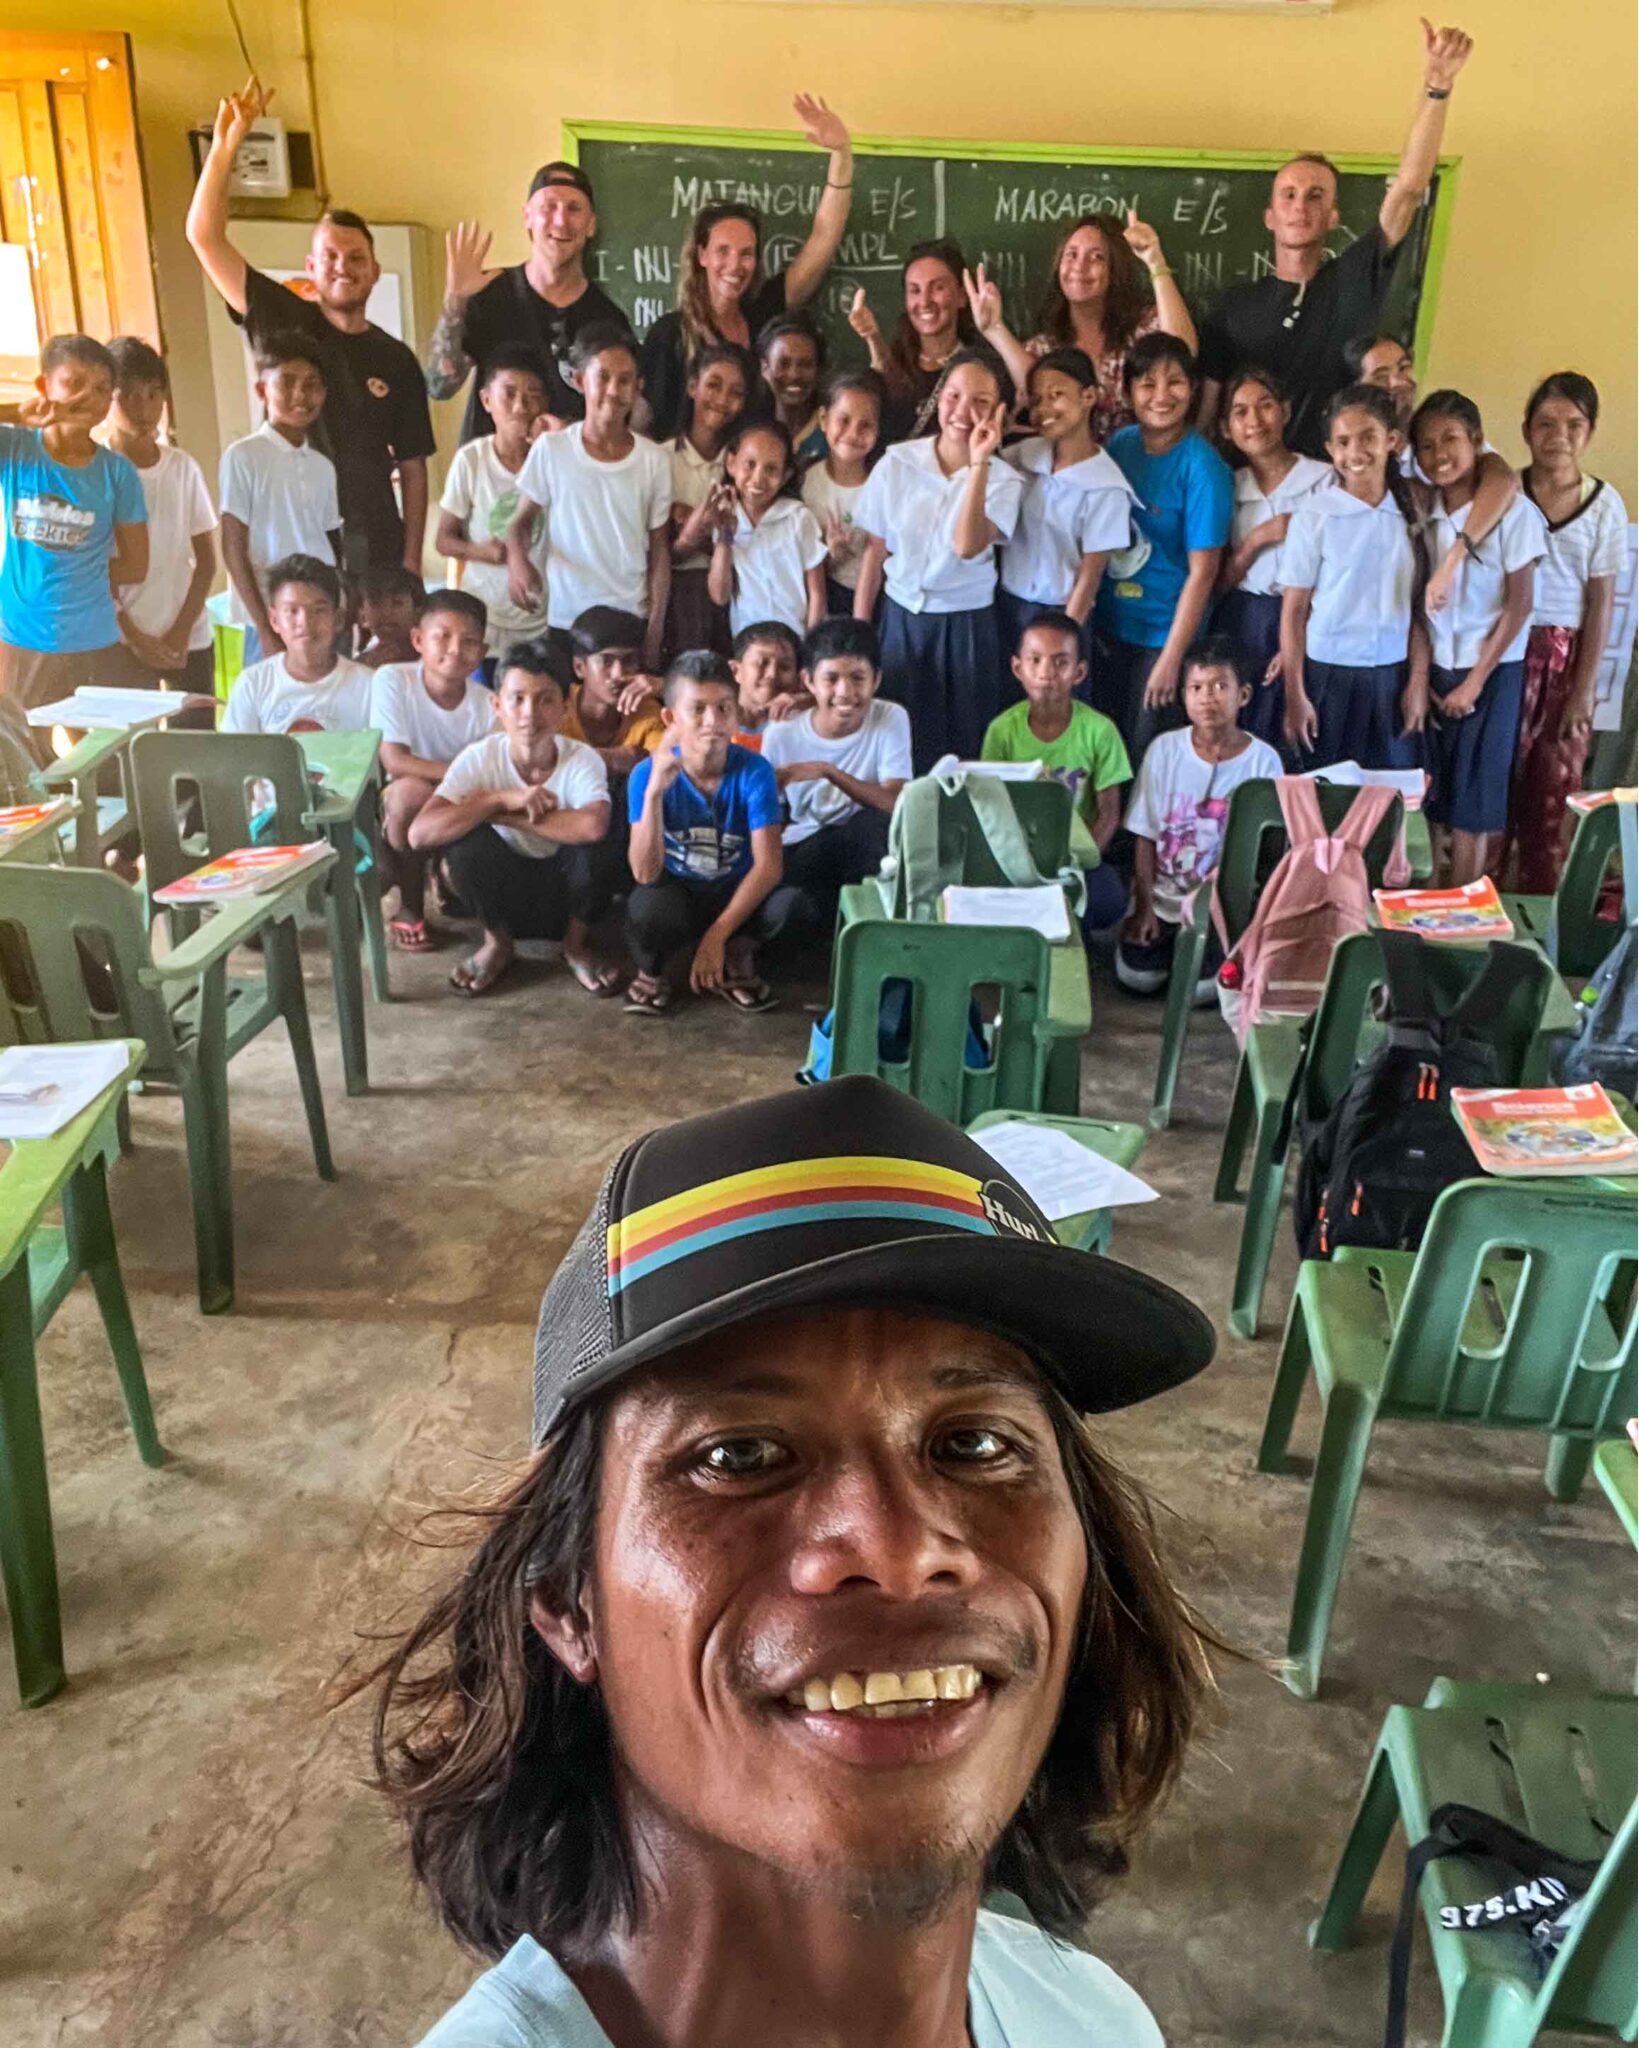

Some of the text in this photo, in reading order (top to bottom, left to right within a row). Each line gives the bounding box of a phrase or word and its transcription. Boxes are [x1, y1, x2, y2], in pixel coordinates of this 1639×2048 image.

[671, 175, 918, 231] MATANGU E/S
[1173, 188, 1229, 236] E/S
